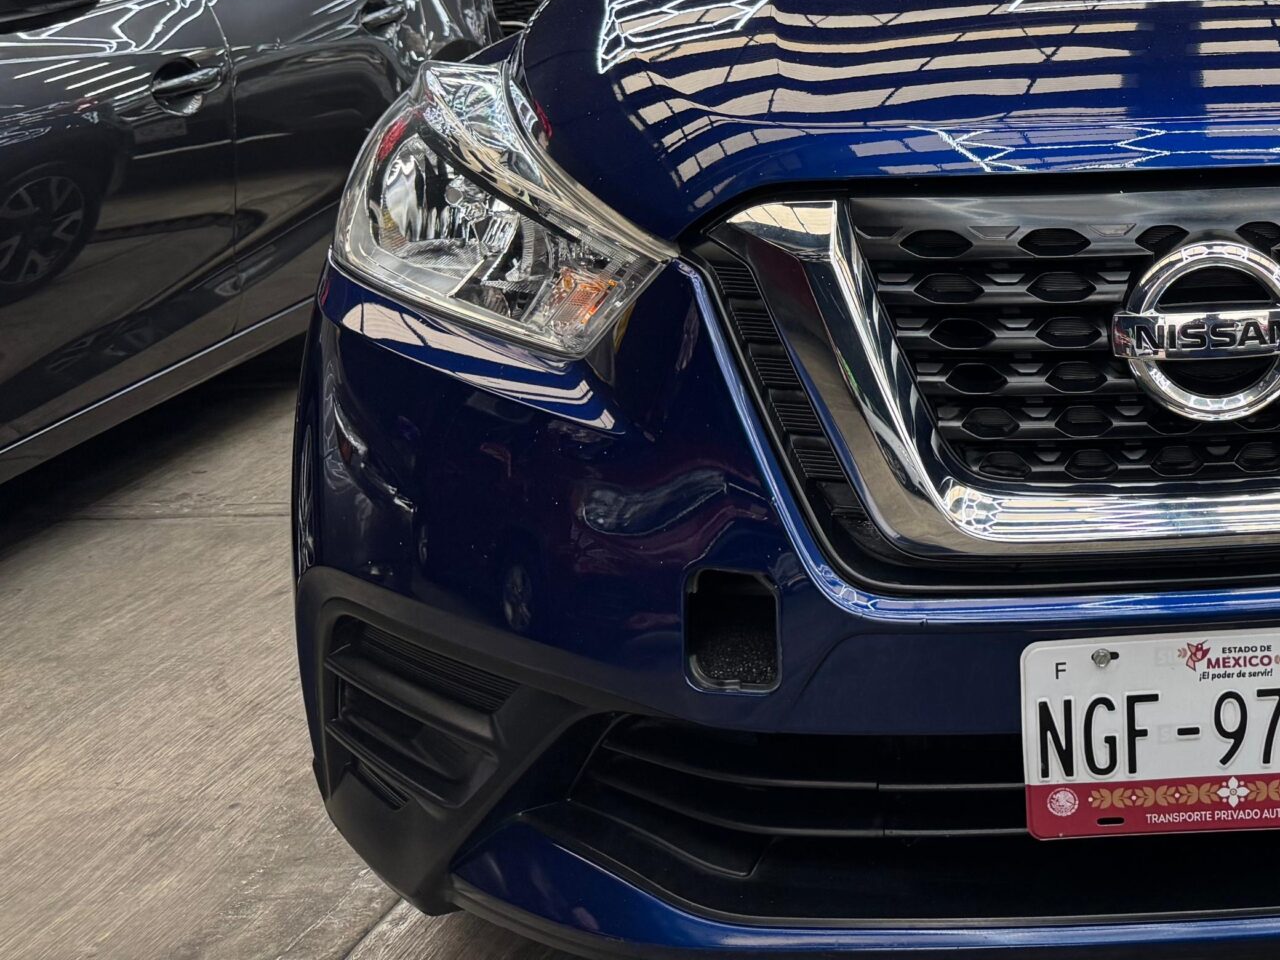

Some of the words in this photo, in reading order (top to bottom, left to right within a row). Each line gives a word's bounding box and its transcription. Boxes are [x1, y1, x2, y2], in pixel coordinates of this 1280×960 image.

[1222, 645, 1258, 654] ESTADO
[1260, 644, 1272, 652] DE
[1206, 654, 1273, 669] MÉXICO
[1055, 662, 1067, 679] F
[1199, 671, 1210, 681] ¡El
[1211, 670, 1234, 681] poder
[1236, 669, 1246, 678] de
[1248, 668, 1273, 677] servir!
[1145, 810, 1212, 823] TRANSPORTE
[1214, 808, 1261, 821] PRIVADO
